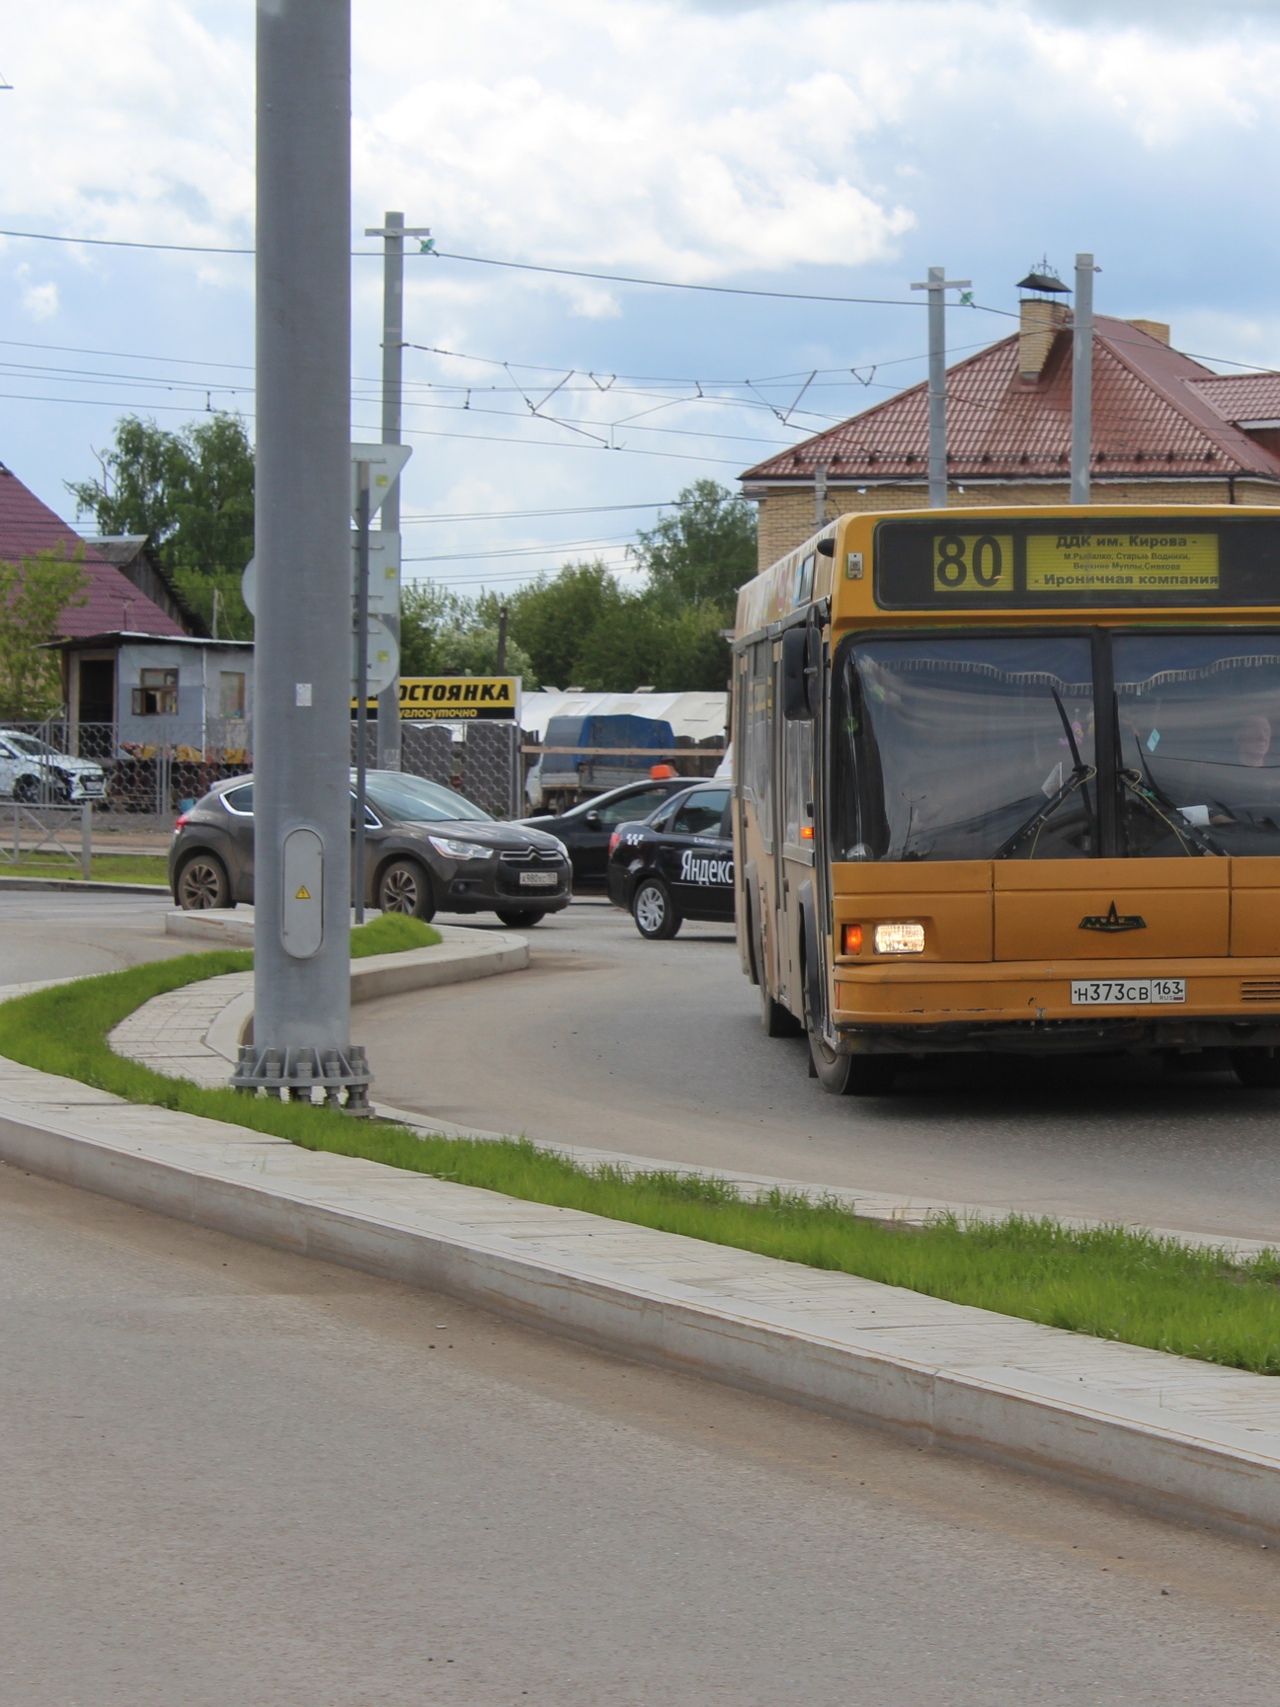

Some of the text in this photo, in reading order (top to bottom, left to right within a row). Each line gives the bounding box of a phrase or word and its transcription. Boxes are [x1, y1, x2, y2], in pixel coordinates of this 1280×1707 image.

[1056, 535, 1091, 549] ДДК
[1097, 538, 1123, 547] им.
[1129, 535, 1187, 549] Кирова
[937, 535, 1002, 588] 80
[1116, 552, 1149, 561] Старые
[1043, 574, 1134, 587] Ироничная
[1139, 576, 1219, 585] компания
[351, 684, 510, 701] ОСТОЯНКА
[399, 708, 479, 720] углосуточно
[680, 850, 734, 885] Яндекс
[1077, 983, 1149, 1002] Н373СВ
[1154, 981, 1180, 995] 163
